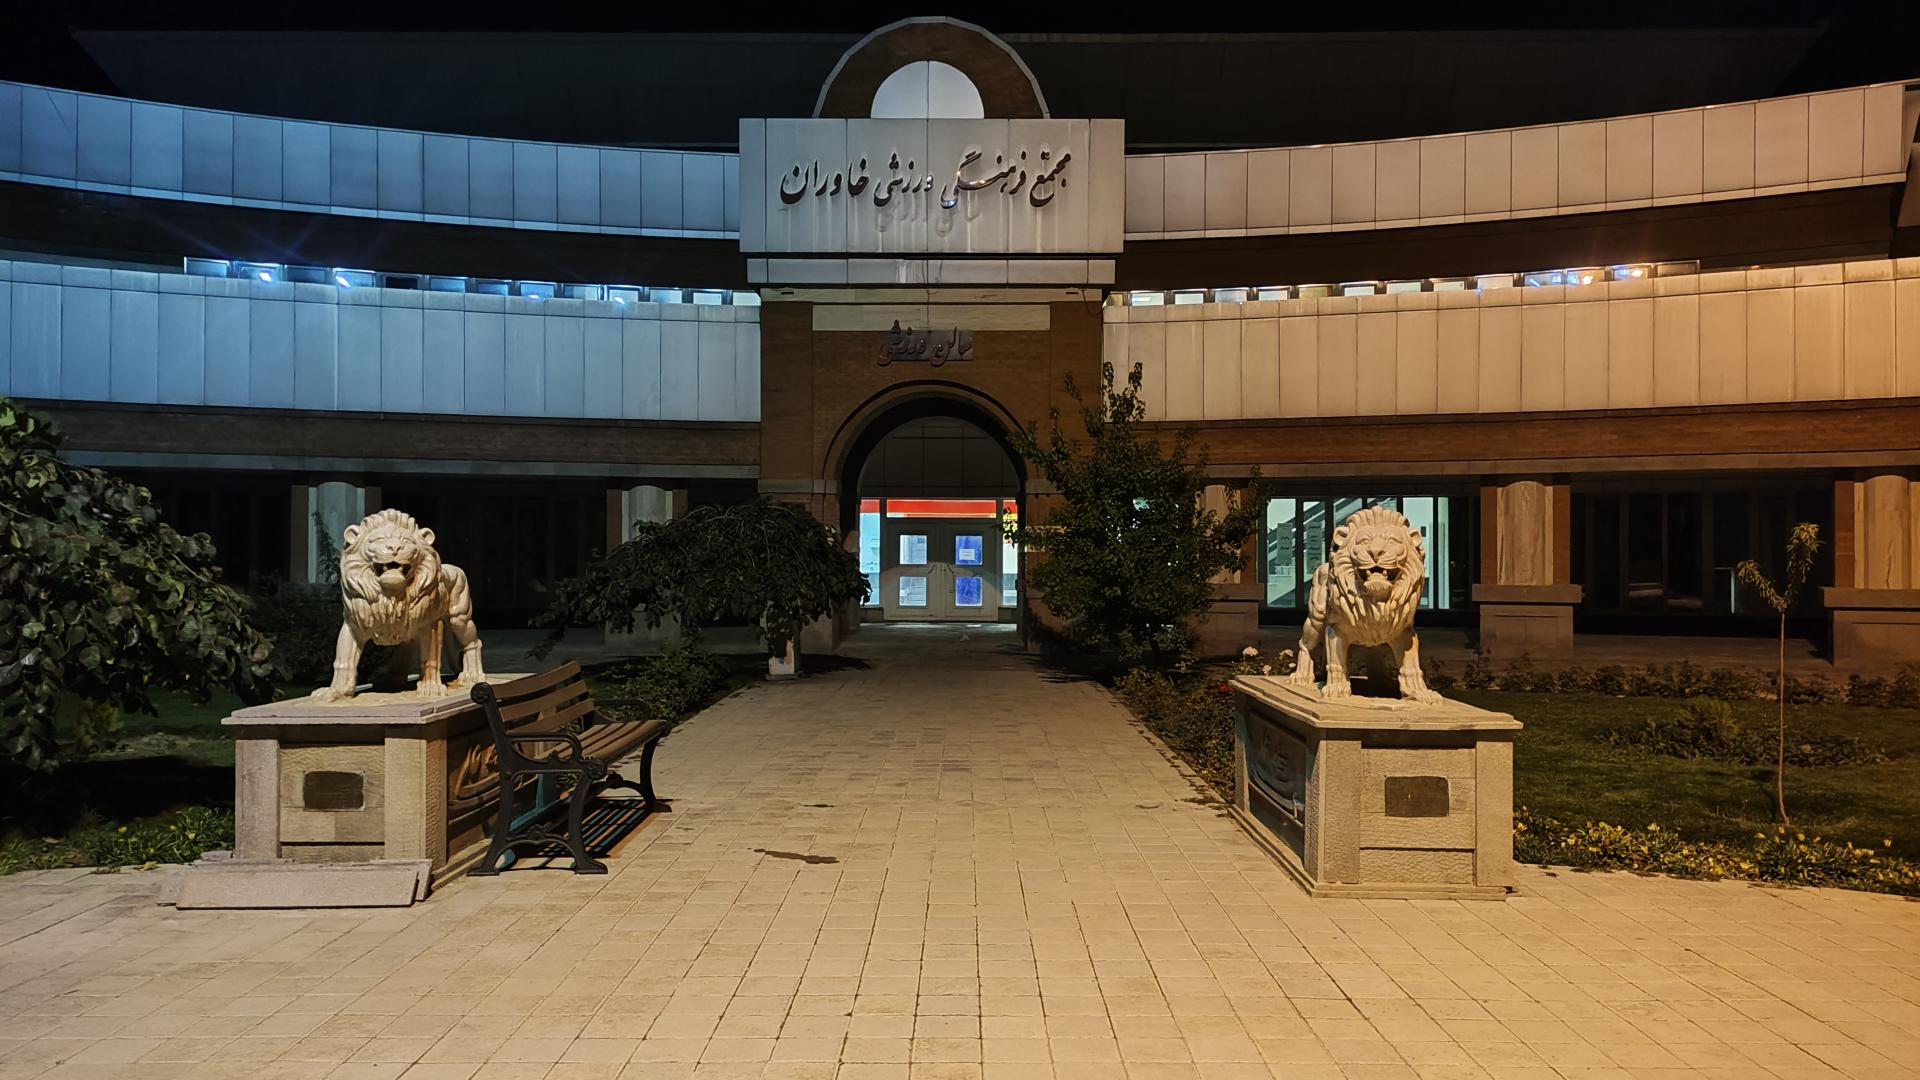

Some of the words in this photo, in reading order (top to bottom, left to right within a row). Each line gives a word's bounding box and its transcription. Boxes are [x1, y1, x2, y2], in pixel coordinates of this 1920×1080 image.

[780, 157, 870, 205] خاوران
[873, 152, 934, 207] ورزشی
[940, 150, 1027, 210] فرهنگی
[1029, 150, 1071, 208] مجتمع
[877, 319, 928, 367] ورزشی
[928, 325, 974, 368] سالن
